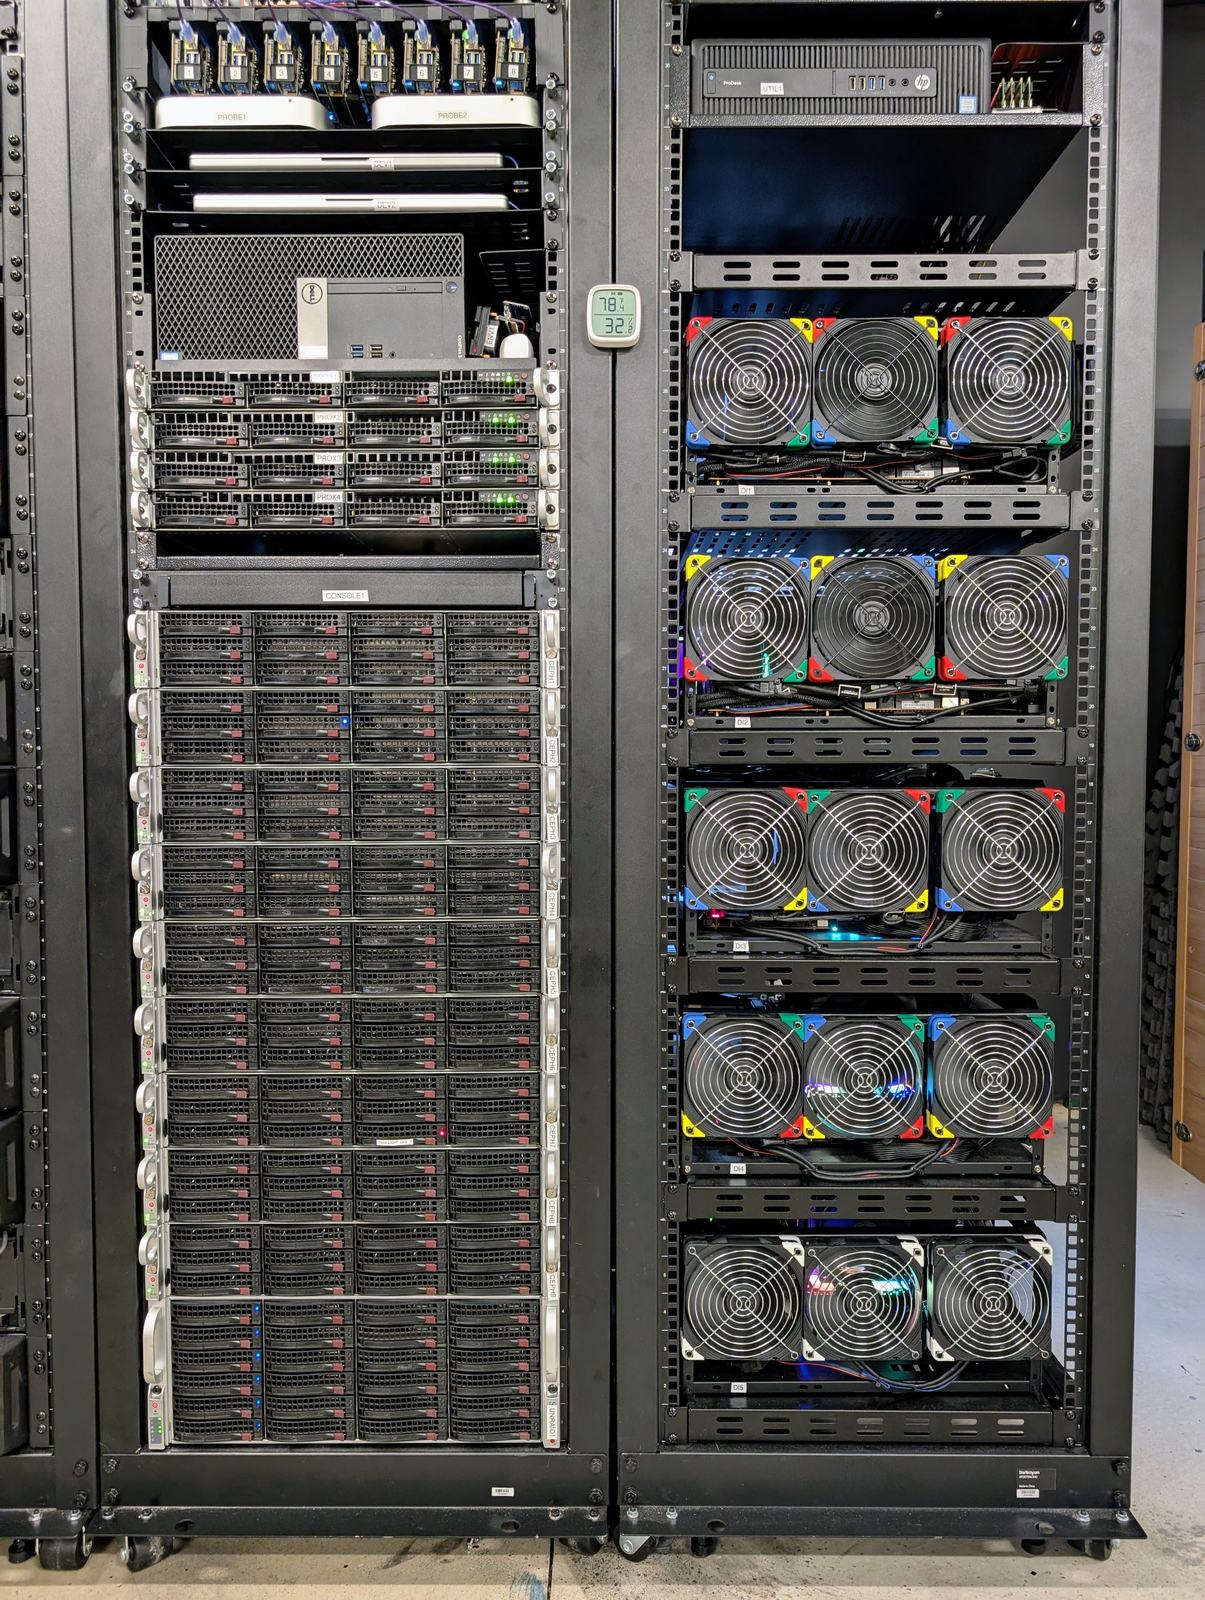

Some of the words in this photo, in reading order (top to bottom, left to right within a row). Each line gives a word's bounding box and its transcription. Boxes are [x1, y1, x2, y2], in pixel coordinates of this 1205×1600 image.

[233, 69, 238, 77] 2
[279, 68, 284, 76] 3
[419, 69, 425, 77] 6
[916, 74, 930, 91] hp
[762, 85, 782, 93] UTIL1
[373, 160, 392, 168] DEV1
[377, 201, 396, 209] DEV2
[599, 297, 625, 312] 78.4
[605, 317, 633, 334] 32.2
[486, 326, 497, 345] ENV1
[326, 592, 364, 600] CONSOLE1
